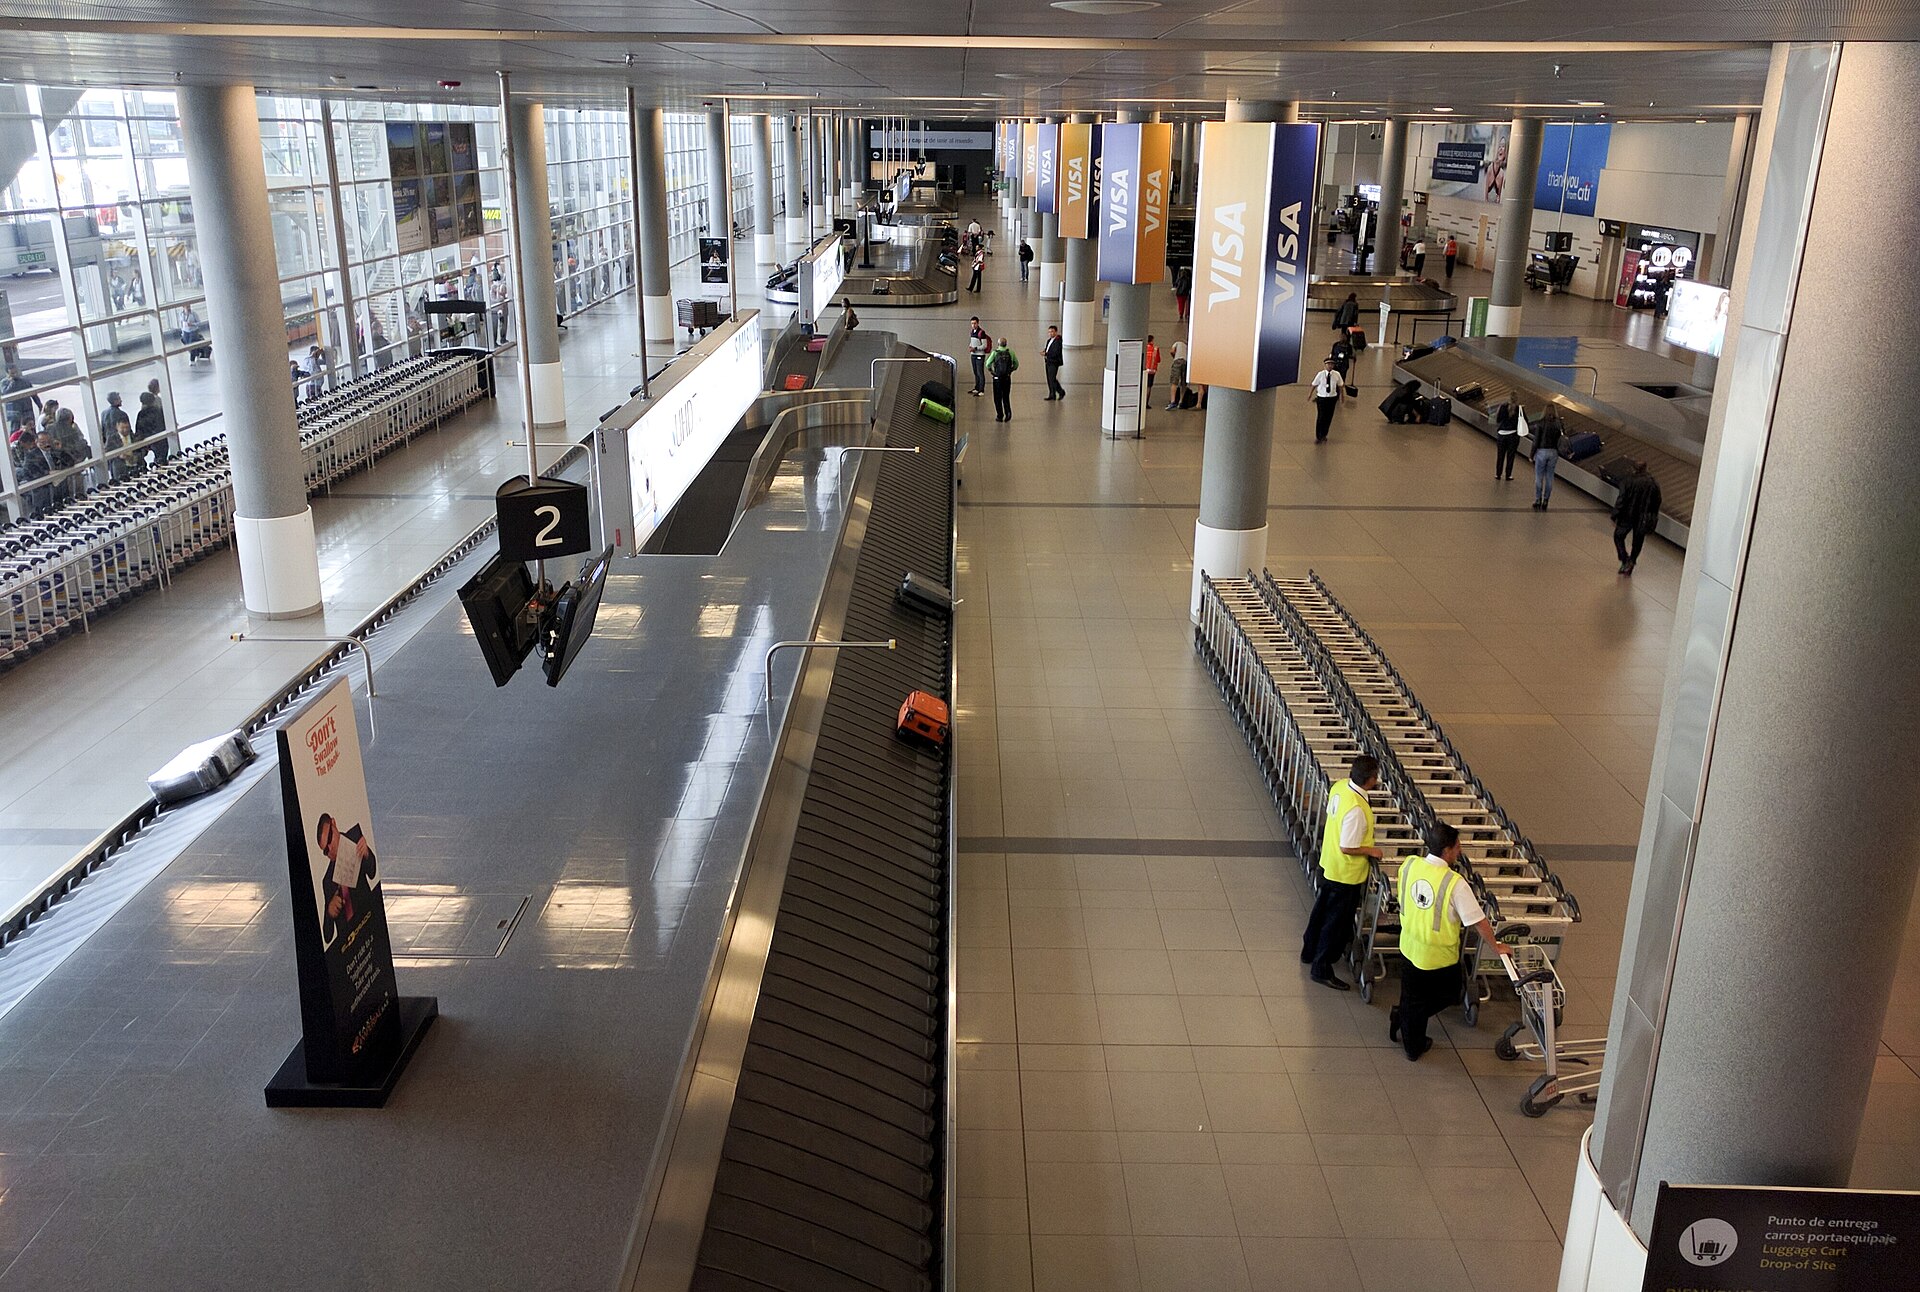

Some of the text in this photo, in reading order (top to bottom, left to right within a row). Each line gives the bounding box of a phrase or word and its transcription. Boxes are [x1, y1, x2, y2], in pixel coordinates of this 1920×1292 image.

[1026, 145, 1036, 176] VISA
[1041, 149, 1052, 188] VISA
[1068, 157, 1083, 206] VISA
[1565, 176, 1580, 191] you
[884, 192, 890, 201] 4
[1353, 197, 1359, 206] 3
[1577, 183, 1591, 202] citi
[1109, 169, 1129, 238] VISA
[1144, 169, 1162, 239] VISA
[842, 223, 851, 236] 2
[1561, 236, 1568, 249] 1
[1208, 202, 1247, 313] VISA
[1272, 201, 1302, 317] VISA
[534, 505, 563, 547] 2
[310, 716, 336, 753] Don't
[313, 736, 338, 765] Swallow
[316, 765, 327, 777] The
[1768, 1215, 1878, 1231] Punto de entrega
[1765, 1232, 1897, 1246] carros portaequipaje
[1762, 1244, 1848, 1258] Luggage Cart
[1760, 1259, 1837, 1271] Drop-of Site
